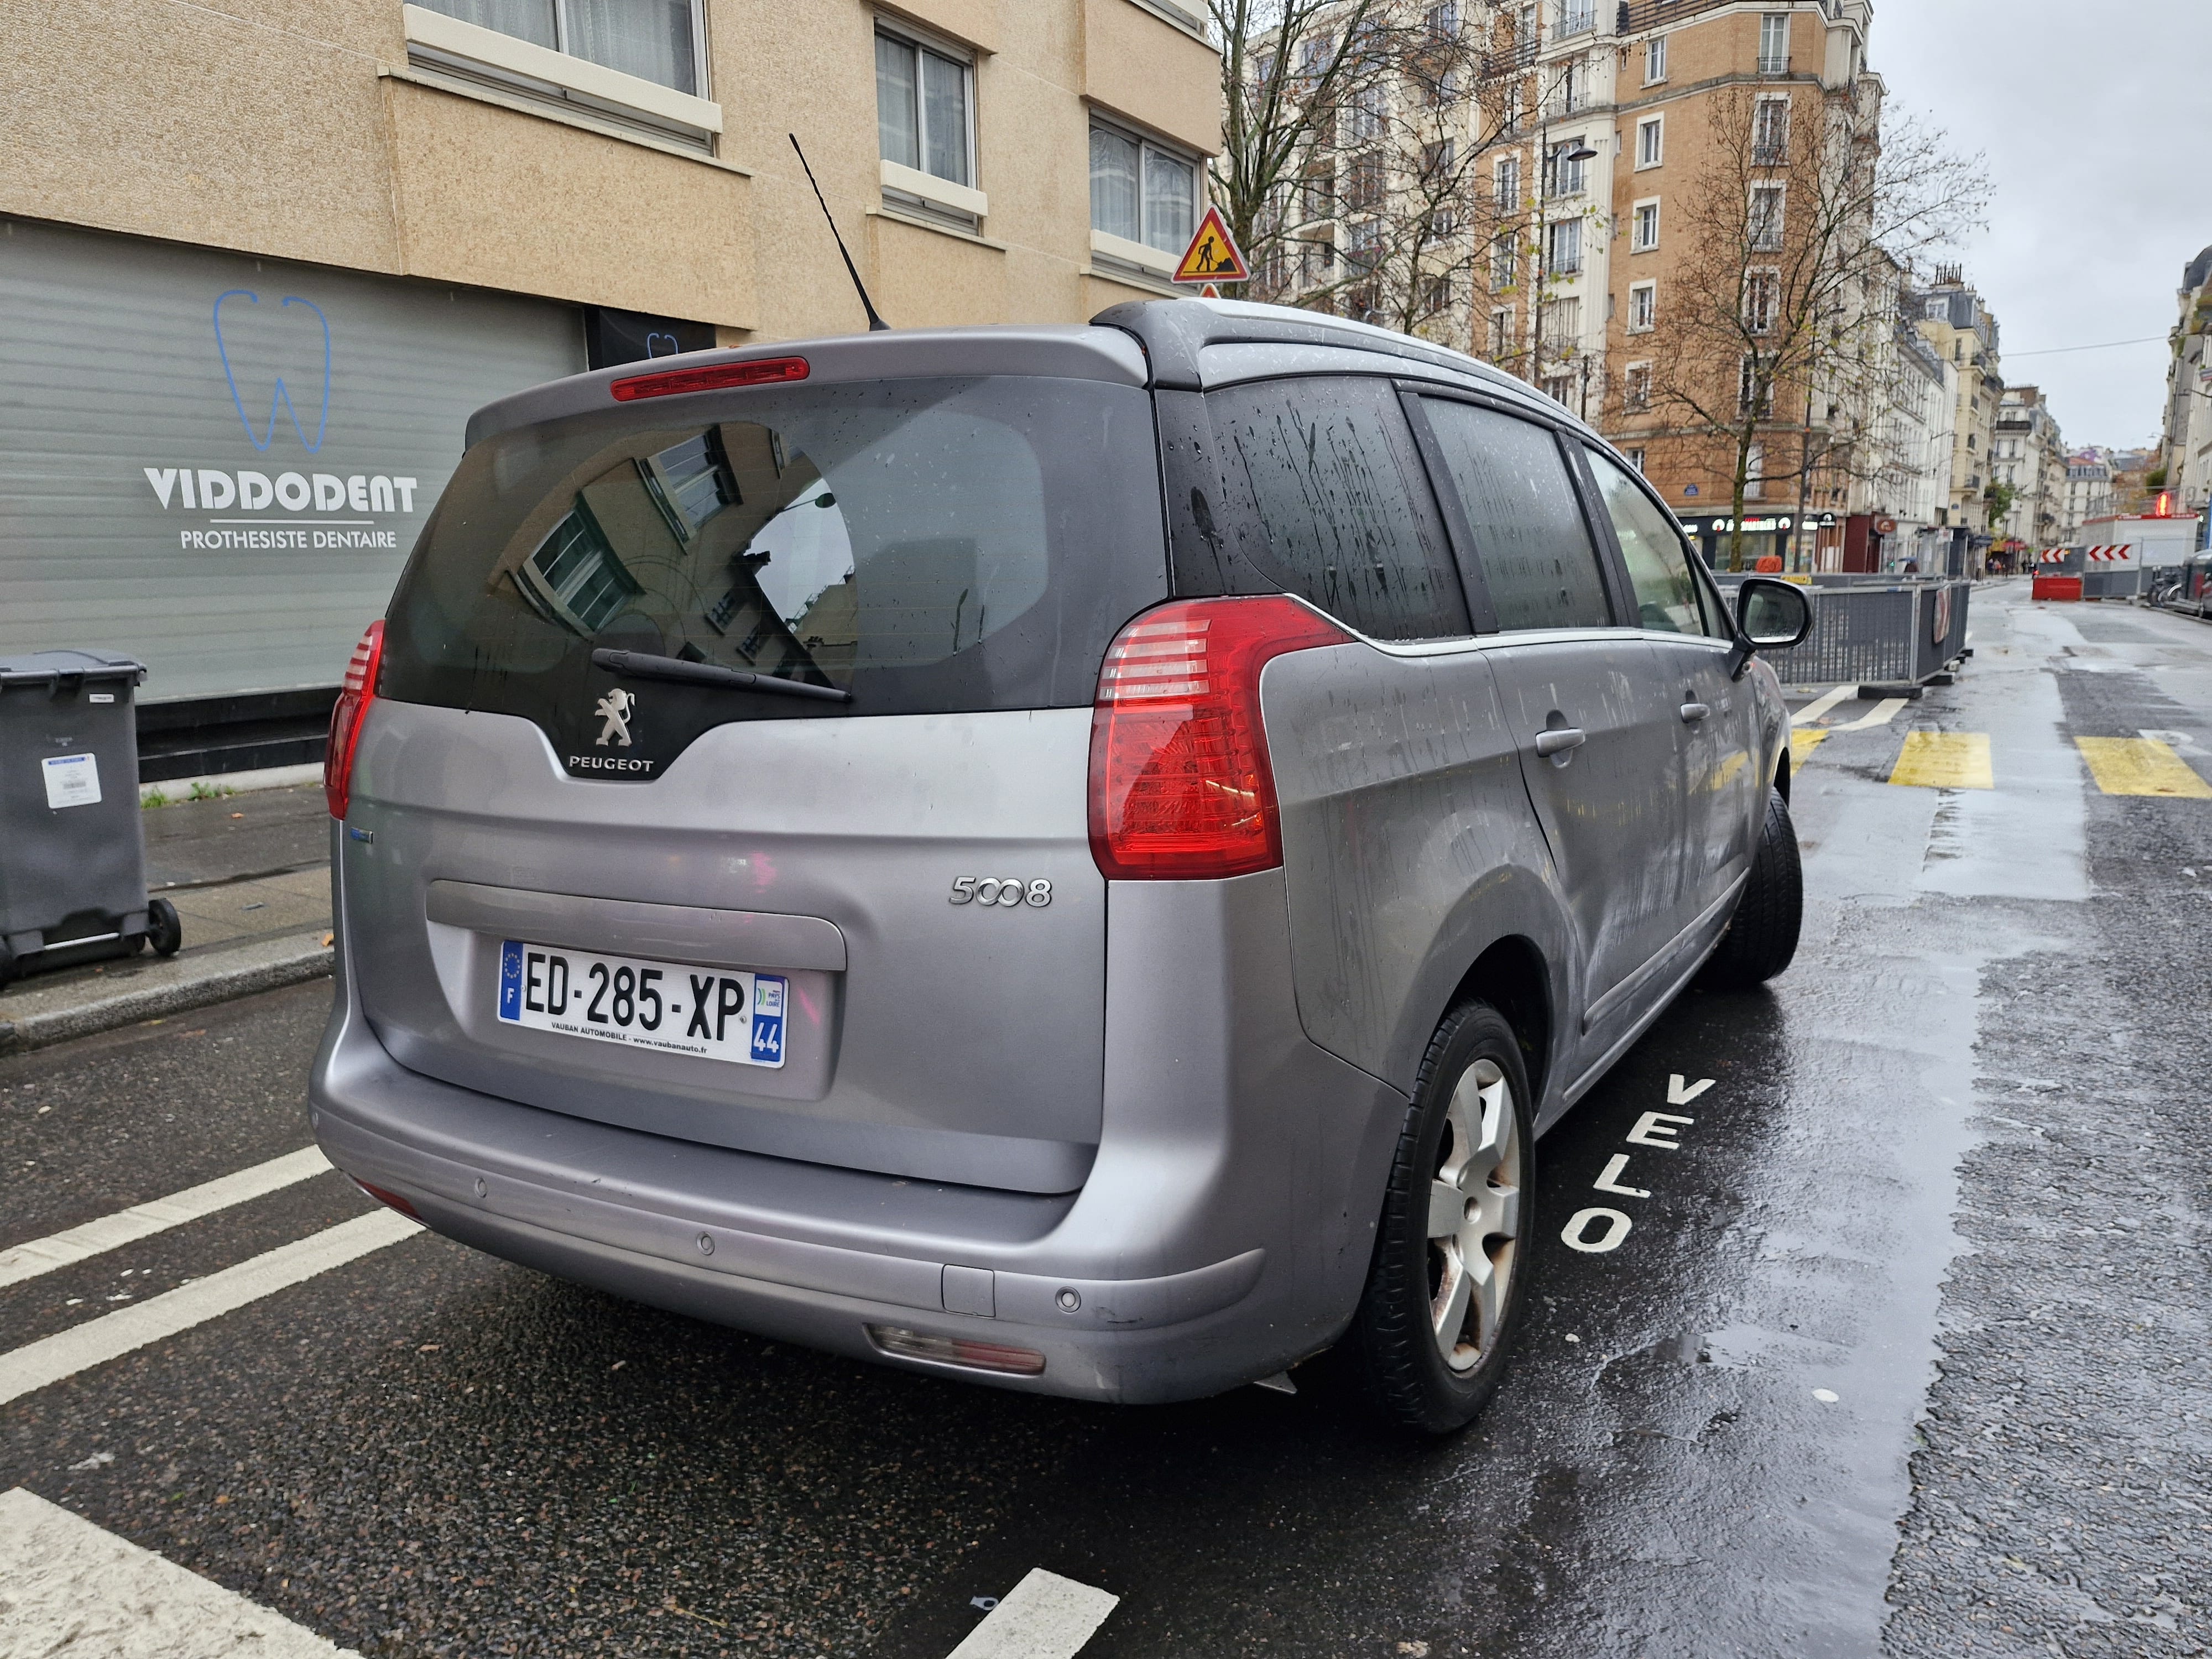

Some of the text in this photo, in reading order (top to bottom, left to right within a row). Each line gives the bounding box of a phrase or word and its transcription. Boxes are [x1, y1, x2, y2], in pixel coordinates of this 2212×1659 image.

[143, 467, 418, 513] VIDDODENT
[181, 530, 397, 549] PROTHESISTE DENTAIRE
[569, 755, 654, 773] PEUGEOT
[949, 877, 1052, 907] 5008
[507, 988, 515, 1004] F
[525, 952, 745, 1041] ED-285-XP
[551, 1021, 579, 1033] VAUBAN
[580, 1027, 627, 1041] AUTOMOBILE
[633, 1037, 708, 1054] www.vaubanauto.fr
[754, 1022, 779, 1053] 44
[1561, 1073, 1717, 1253] VELO
